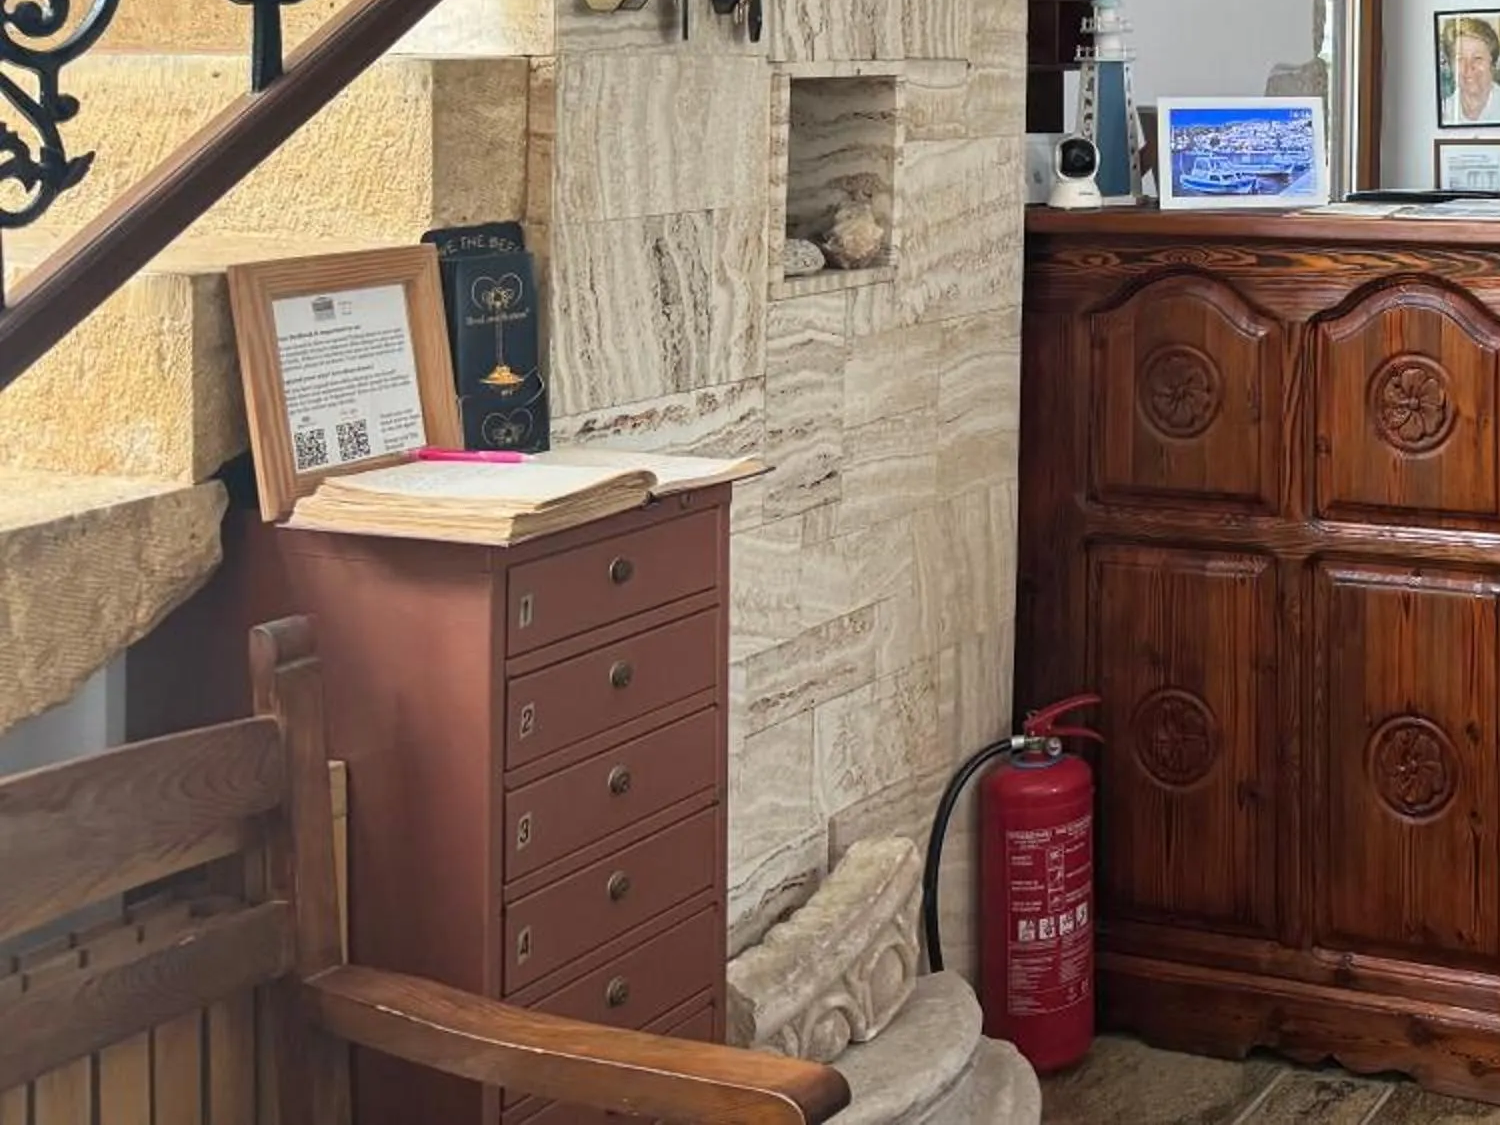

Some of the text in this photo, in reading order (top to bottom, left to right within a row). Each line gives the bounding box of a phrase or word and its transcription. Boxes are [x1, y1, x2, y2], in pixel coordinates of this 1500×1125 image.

[460, 234, 485, 250] THE
[521, 708, 533, 734] 2
[519, 818, 530, 843] 3
[519, 931, 530, 955] 4
